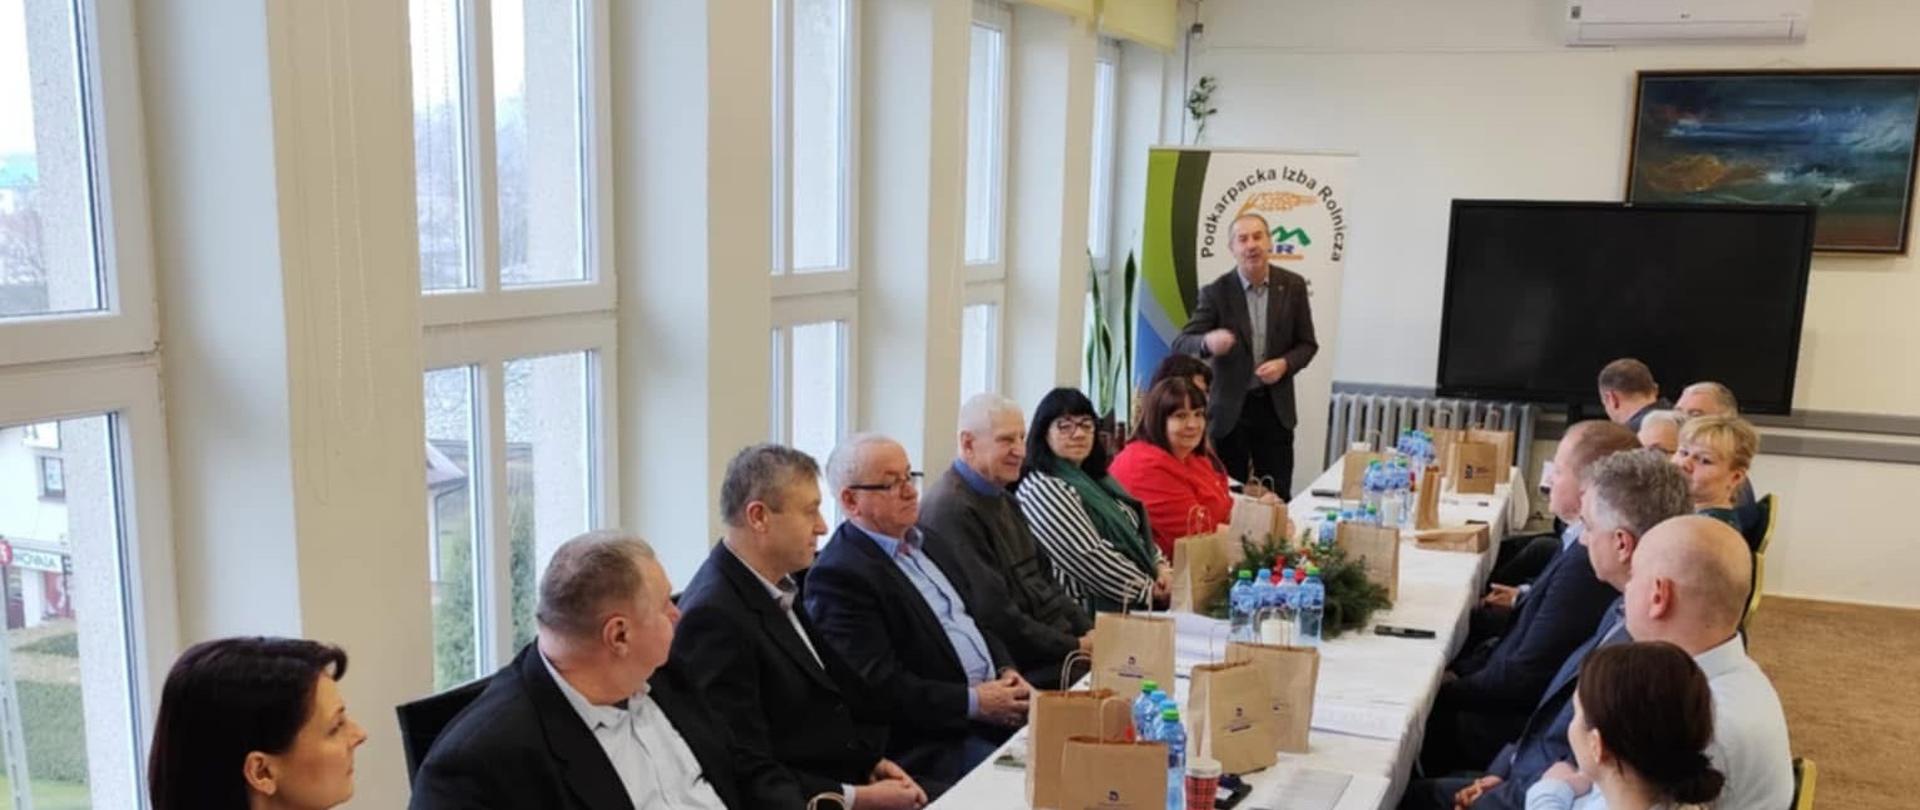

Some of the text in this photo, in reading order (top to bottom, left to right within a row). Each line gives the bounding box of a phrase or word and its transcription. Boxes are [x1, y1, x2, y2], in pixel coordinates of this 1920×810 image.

[1201, 166, 1346, 262] Podkarpacka Izba Rolnicza
